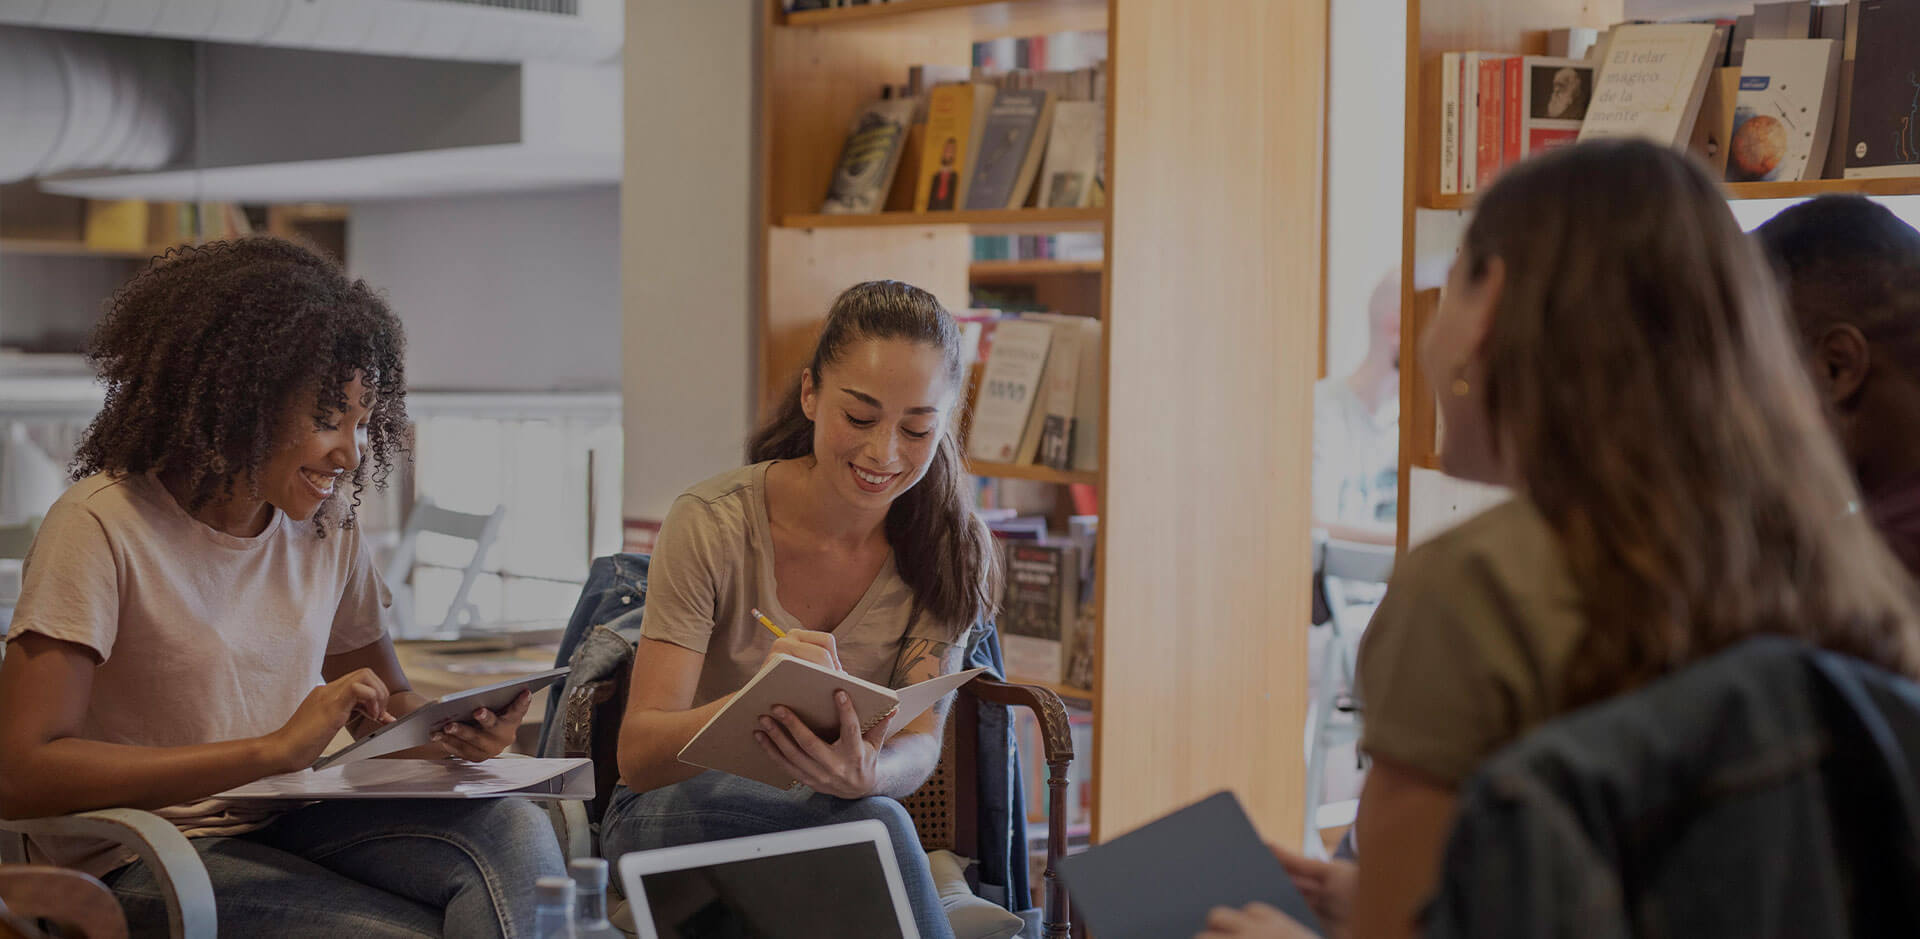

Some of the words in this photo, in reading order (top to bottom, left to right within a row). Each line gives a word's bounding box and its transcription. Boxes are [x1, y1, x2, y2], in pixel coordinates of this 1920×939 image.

[1613, 50, 1630, 64] El
[1632, 49, 1666, 64] telar
[1599, 88, 1617, 102] de
[1620, 87, 1633, 103] la
[1591, 111, 1640, 121] mente
